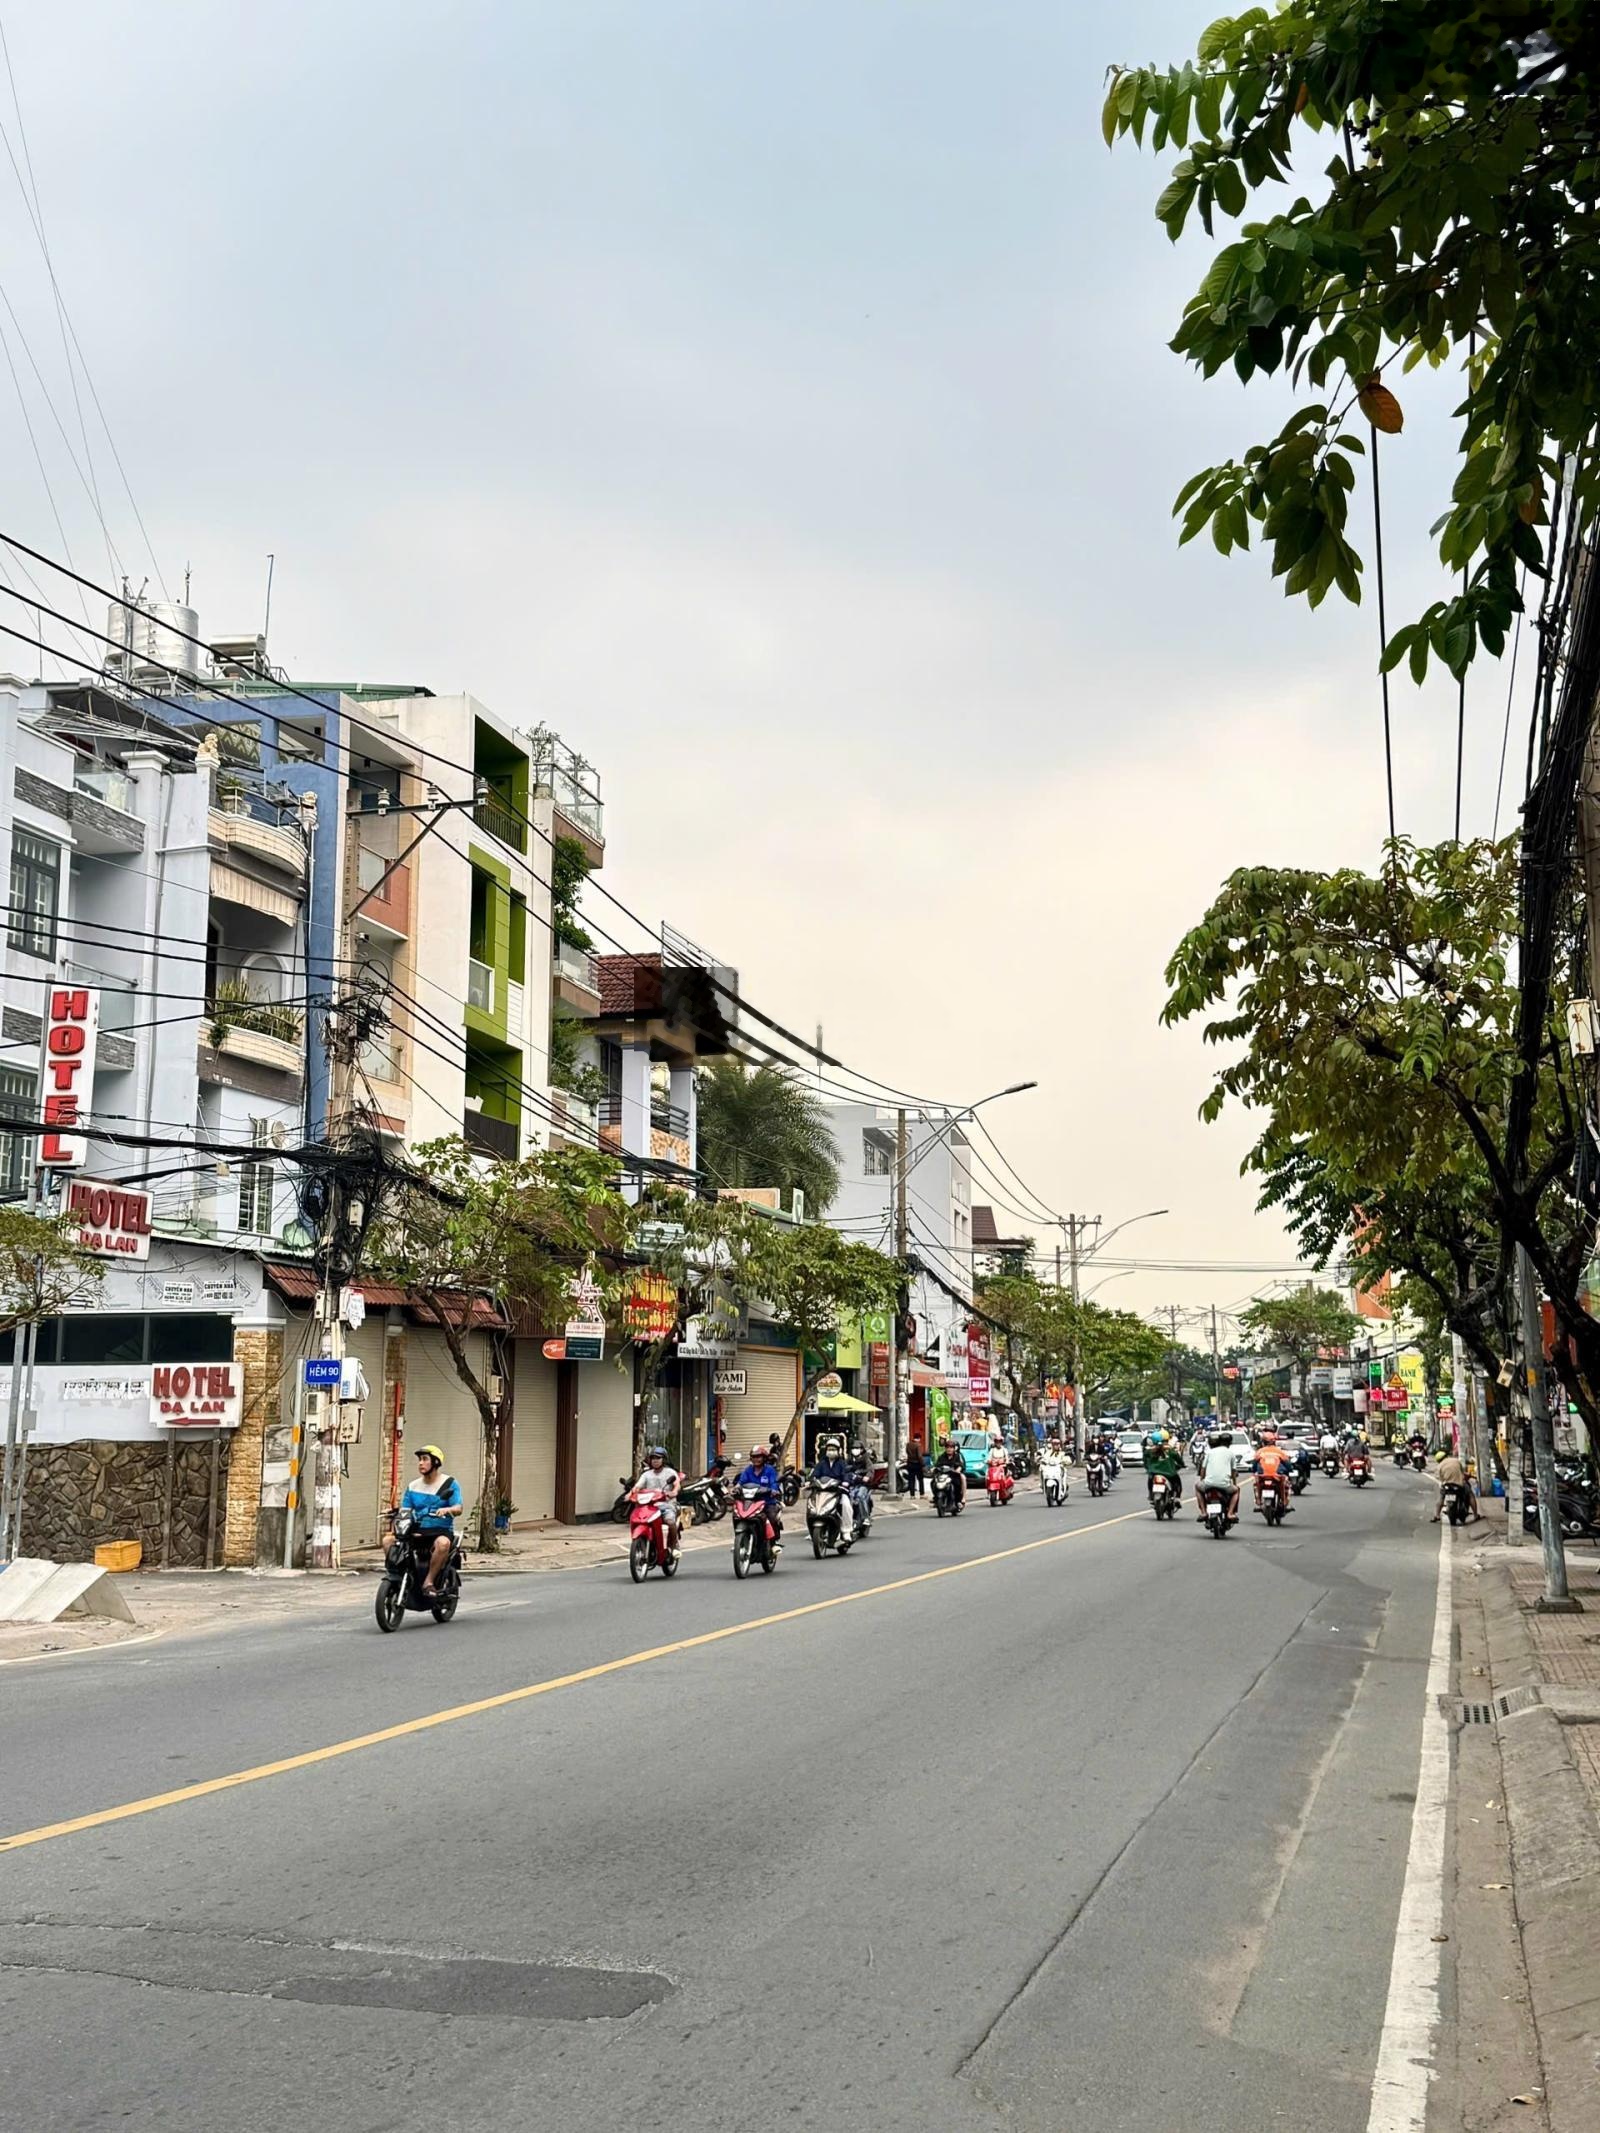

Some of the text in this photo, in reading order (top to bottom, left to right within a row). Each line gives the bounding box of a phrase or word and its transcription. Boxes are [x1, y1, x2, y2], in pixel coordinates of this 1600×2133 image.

[42, 990, 89, 1163] HOTEL
[70, 1184, 152, 1235] HOTEL
[105, 1234, 138, 1253] LAN
[328, 1367, 339, 1376] 90
[715, 1373, 743, 1383] YAMI
[153, 1366, 236, 1399] HOTEL
[190, 1401, 225, 1413] LAN
